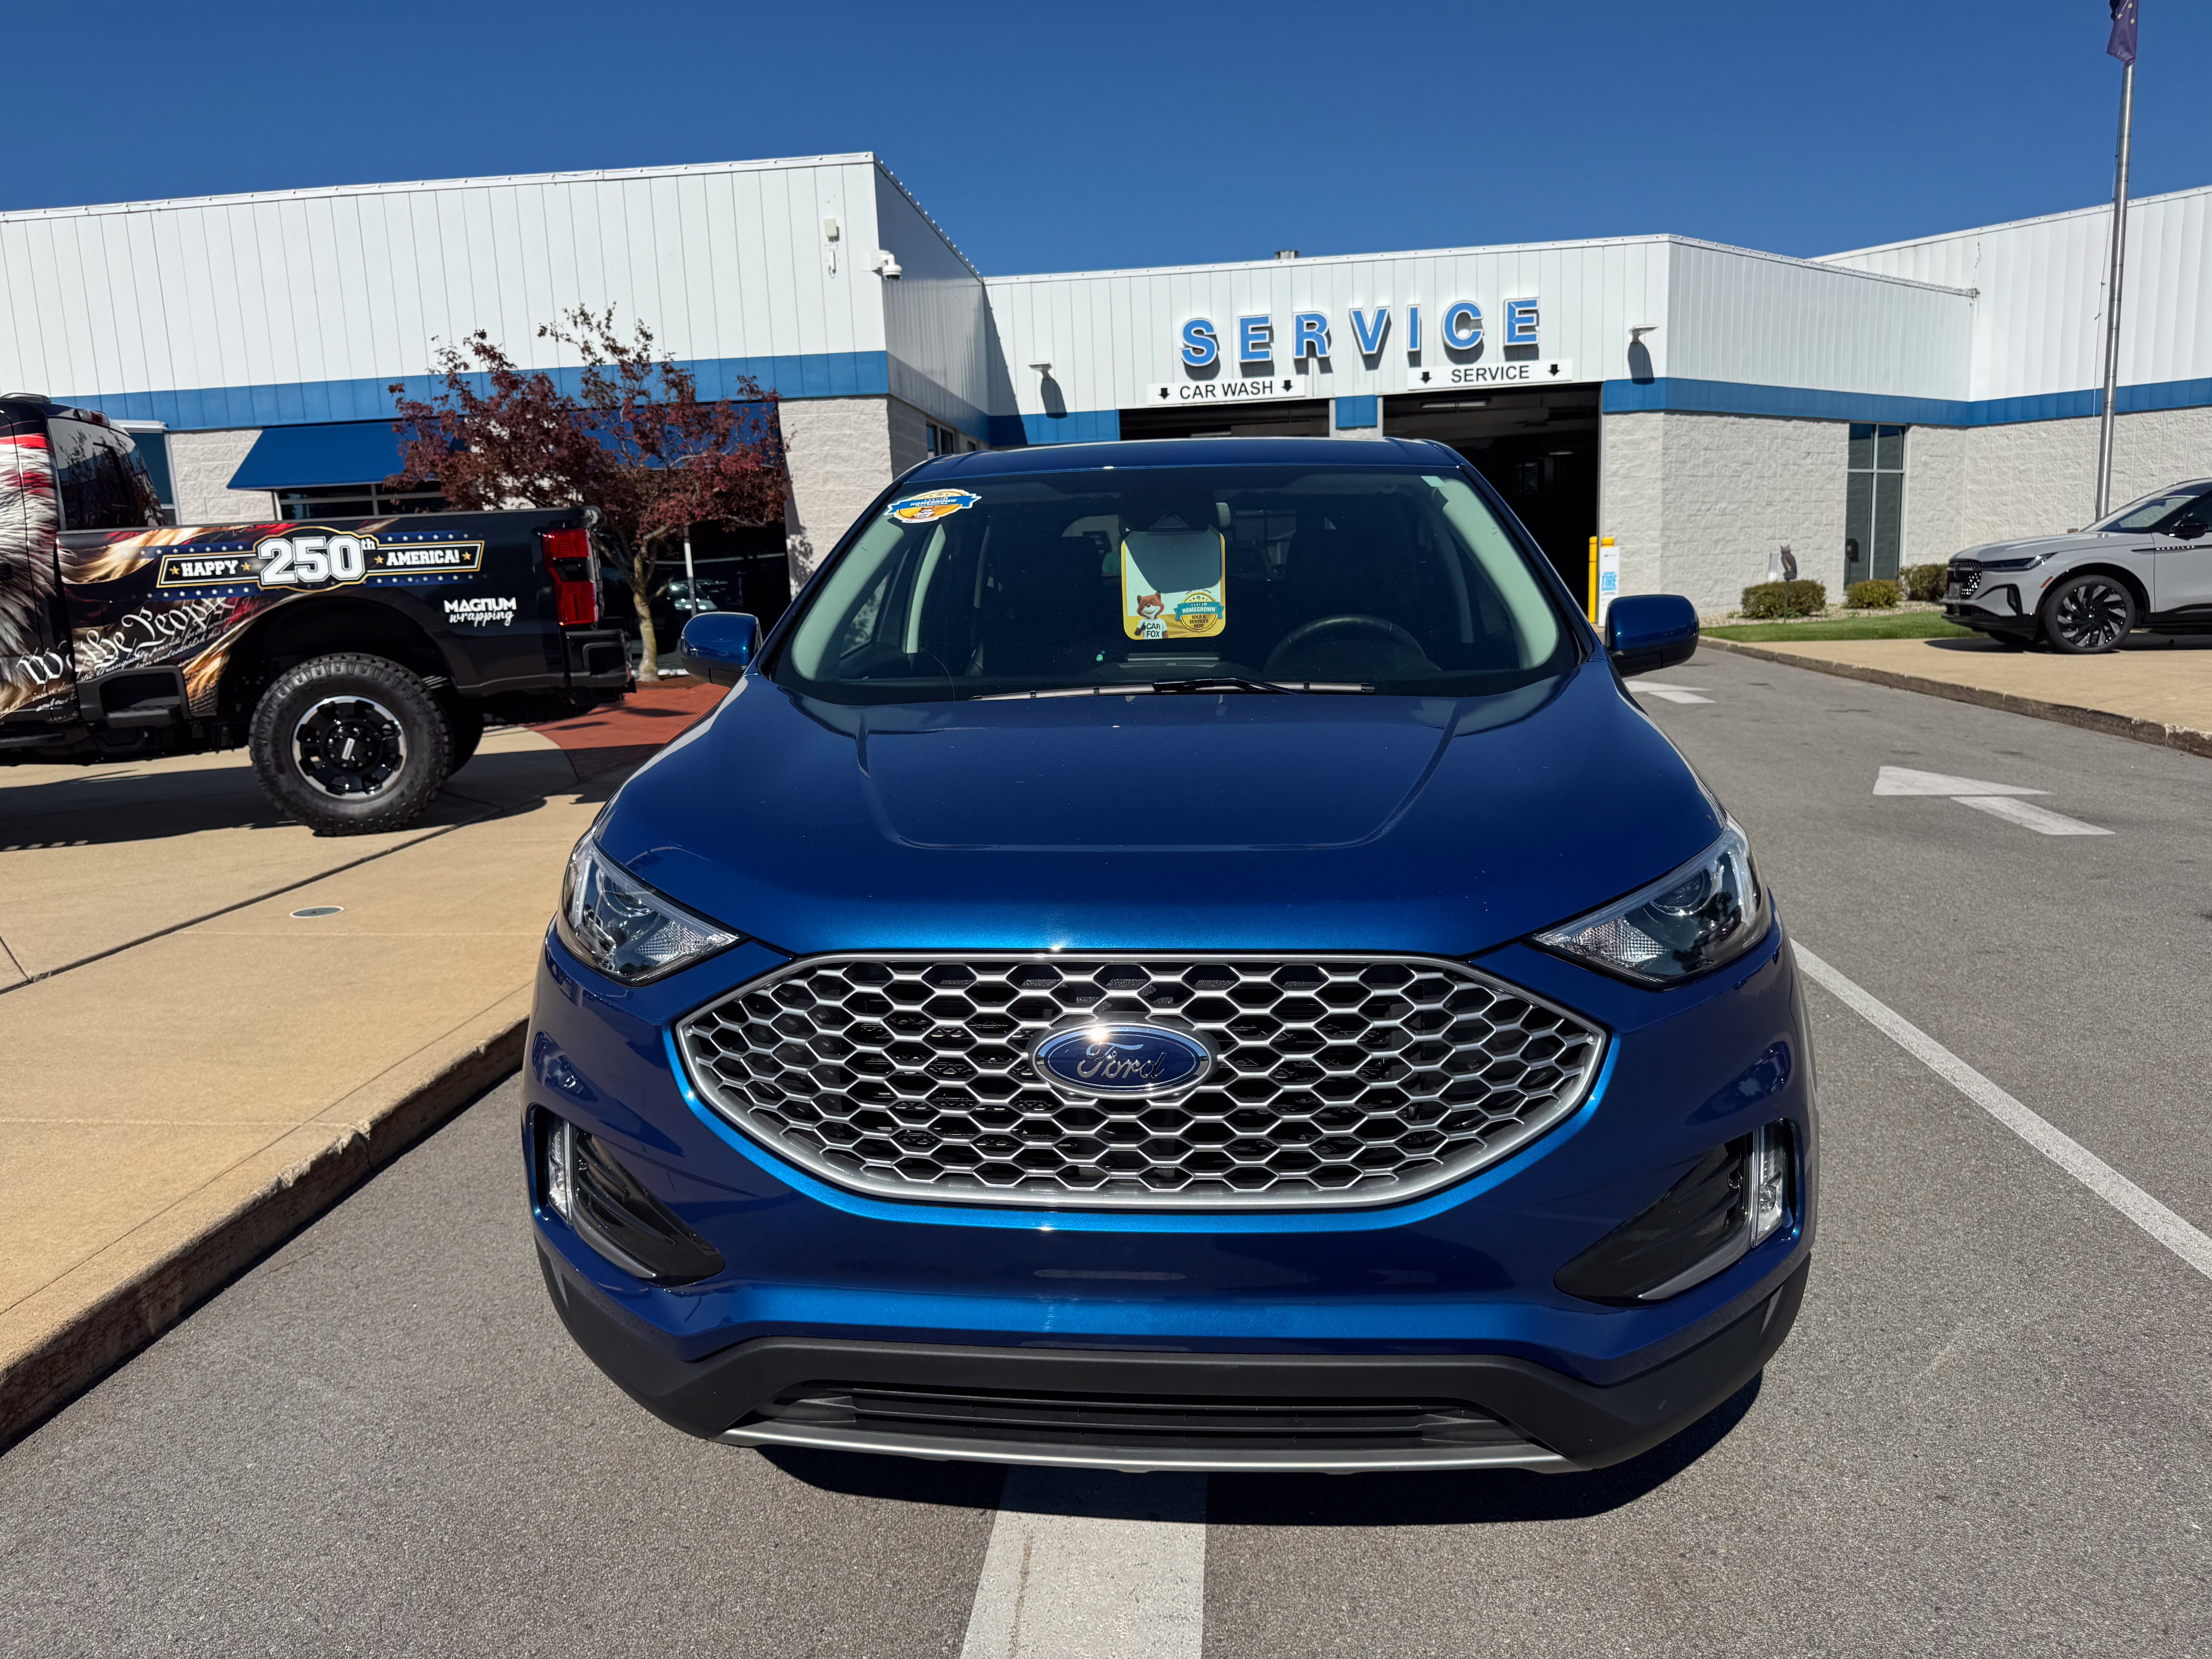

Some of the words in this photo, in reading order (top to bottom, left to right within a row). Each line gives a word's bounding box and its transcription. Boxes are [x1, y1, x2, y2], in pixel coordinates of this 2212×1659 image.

[1180, 297, 1540, 367] SERVICE
[1451, 365, 1530, 383] SERVICE
[1180, 384, 1216, 400] CAR
[1222, 380, 1273, 397] WASH
[181, 560, 238, 577] HAPPY
[386, 549, 460, 566] AMERICA!
[443, 597, 517, 613] MAGNUM
[449, 610, 514, 627] wrapping
[1077, 1041, 1167, 1079] Ford
